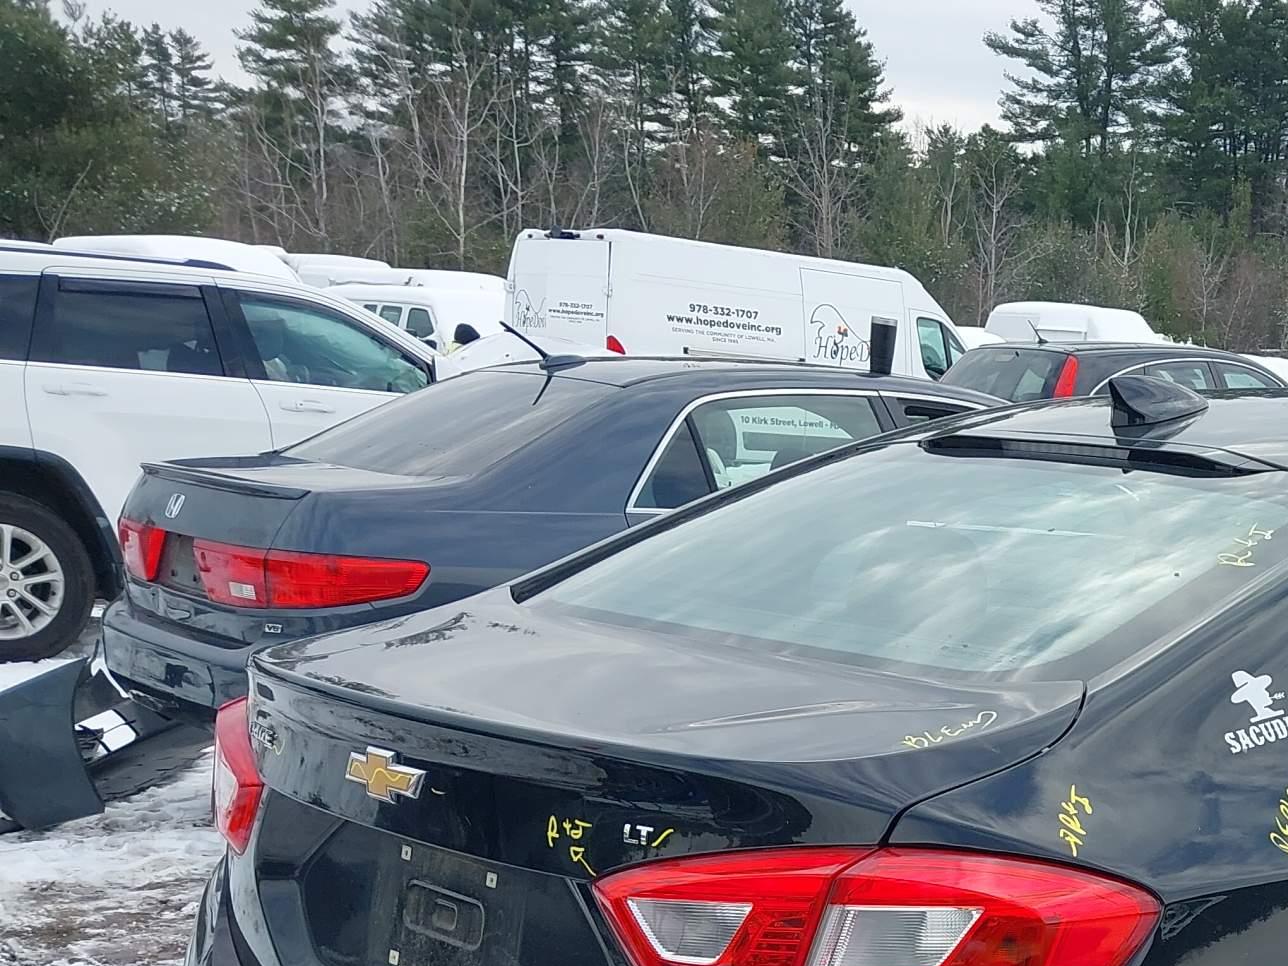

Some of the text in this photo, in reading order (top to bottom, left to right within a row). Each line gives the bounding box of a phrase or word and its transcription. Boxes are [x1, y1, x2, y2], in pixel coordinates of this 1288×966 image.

[688, 303, 760, 320] 978-332-1707
[666, 314, 782, 336] www.hopedoveinc.org
[740, 415, 750, 424] 10
[751, 416, 769, 425] Kirk
[769, 417, 798, 428] Street,
[798, 421, 824, 429] Lowell
[623, 823, 655, 846] LT
